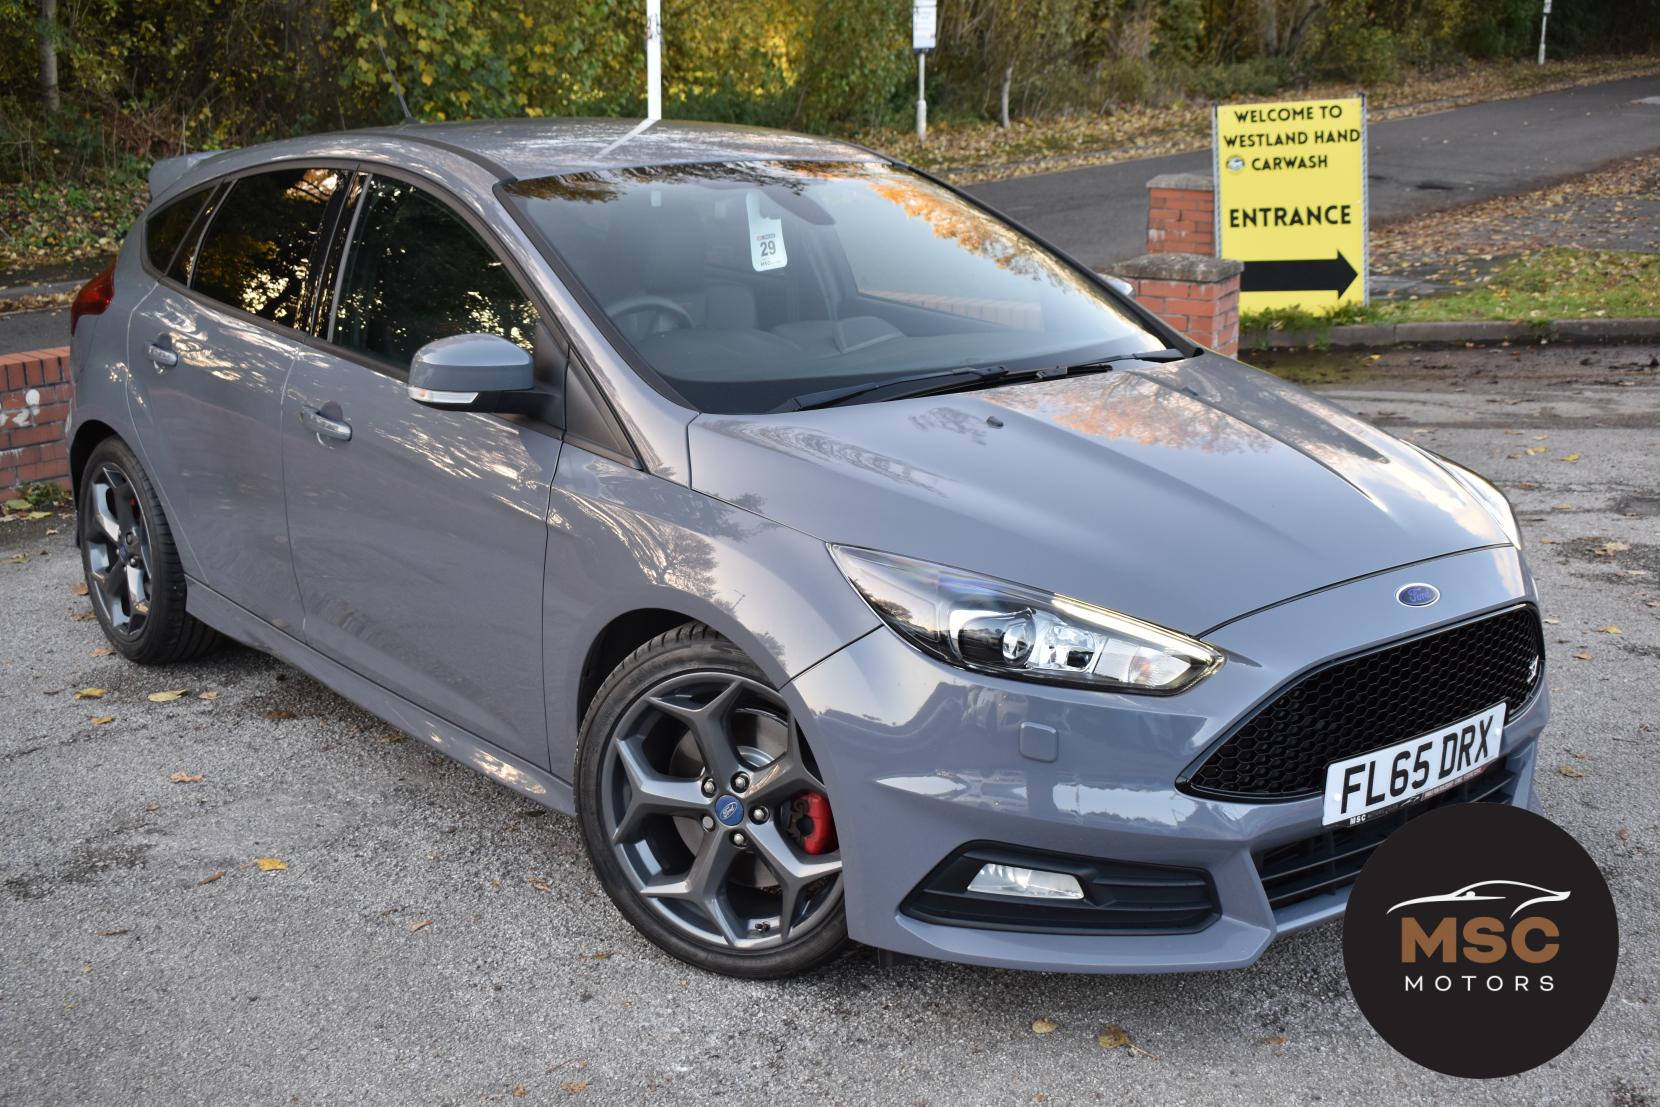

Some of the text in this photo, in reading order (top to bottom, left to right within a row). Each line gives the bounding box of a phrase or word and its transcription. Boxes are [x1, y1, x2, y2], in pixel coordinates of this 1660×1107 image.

[1234, 105, 1342, 123] WELCOME TO
[1223, 129, 1360, 148] WESTLAND HAND
[1251, 155, 1328, 171] CARWASH
[1230, 205, 1351, 228] ENTRANCE
[760, 240, 776, 257] 29
[1340, 741, 1432, 815] FL65
[1438, 715, 1494, 780] DRX
